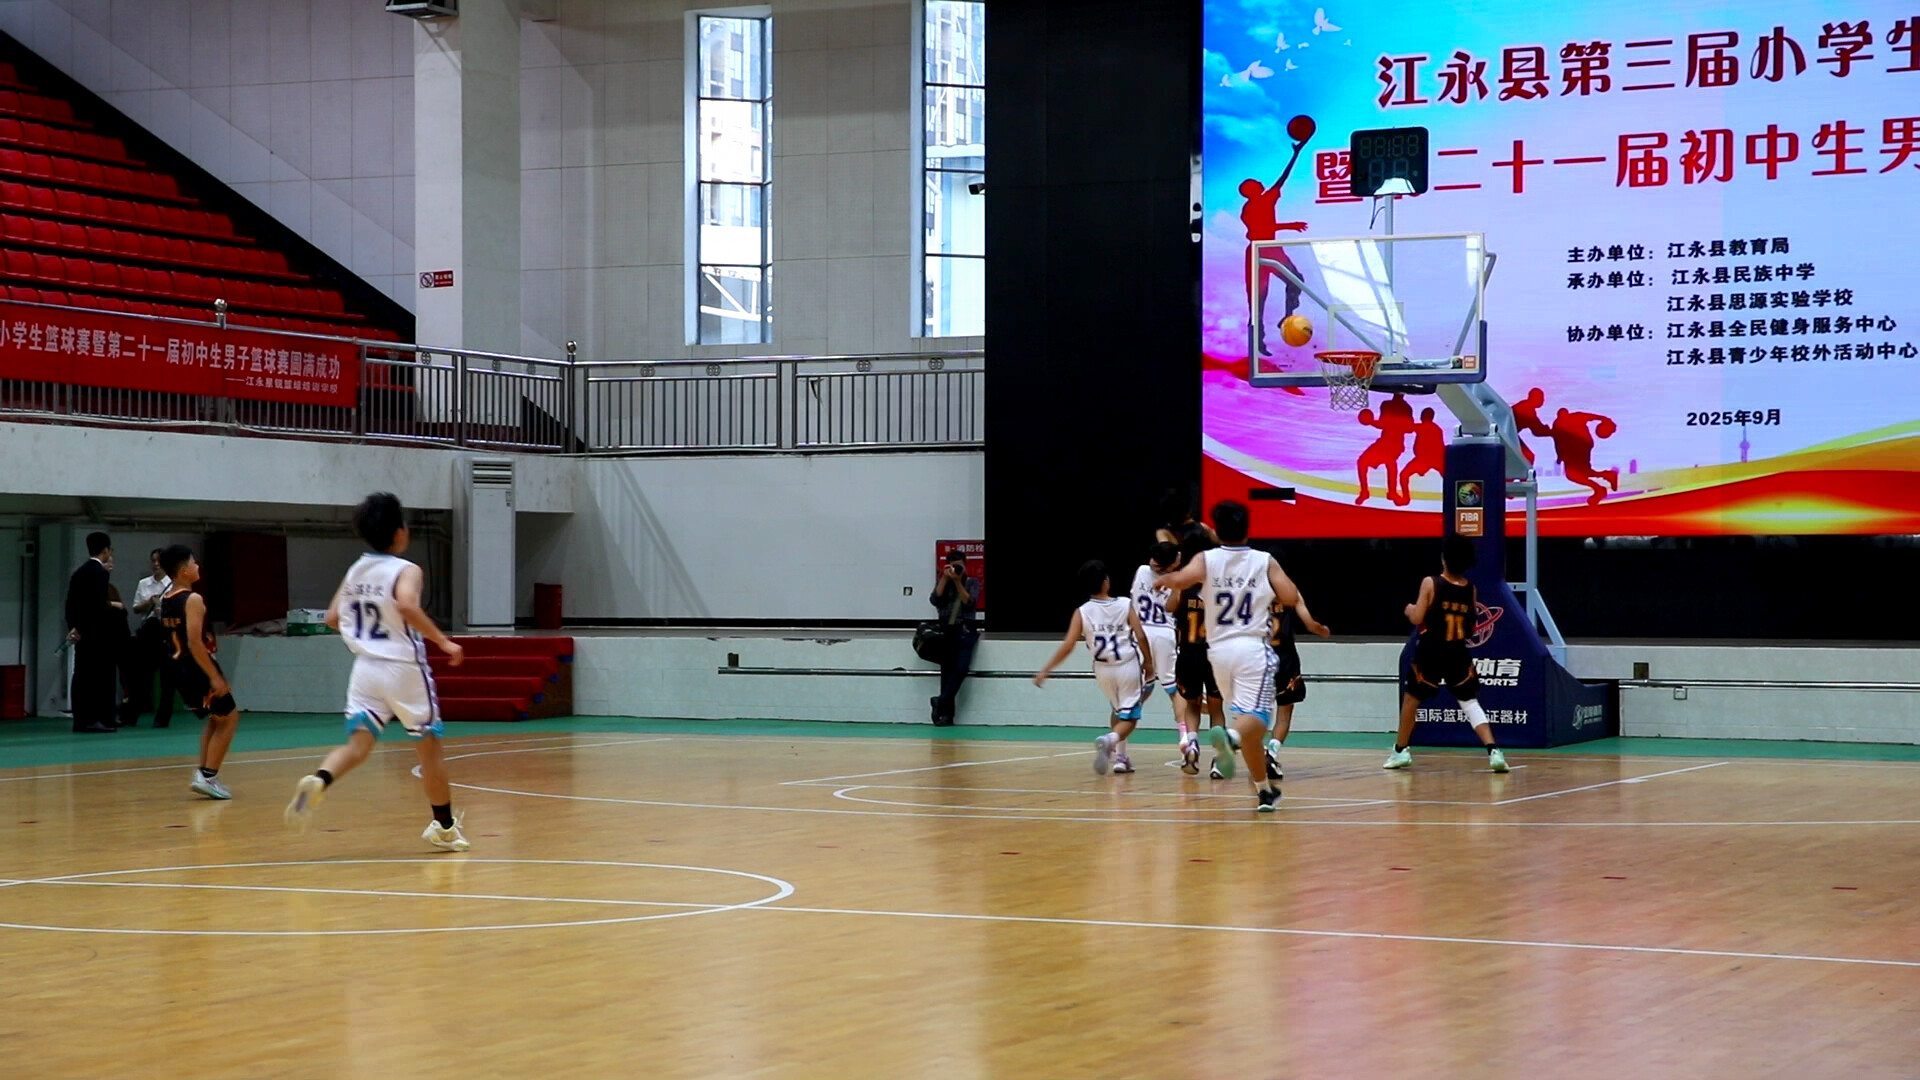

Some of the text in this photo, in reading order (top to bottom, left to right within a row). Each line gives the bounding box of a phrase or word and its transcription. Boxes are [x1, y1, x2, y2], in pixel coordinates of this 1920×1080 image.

[1378, 16, 1920, 108] 江永县第三届小学生
[1315, 117, 1920, 204] 暨二十一届初中生男
[1667, 237, 1790, 258] 江永县教育局
[1671, 263, 1815, 285] 江永县民族中学
[1666, 288, 1853, 312] 江永县思源实验学校
[1666, 315, 1897, 338] 江永县全民健身服务中心
[1666, 342, 1918, 365] 江永县青少年校外活动中心
[1686, 408, 1780, 426] 2025年9月
[1460, 512, 1479, 522] FIBA
[350, 600, 390, 639] 12
[1138, 595, 1167, 624] 30
[1215, 592, 1253, 625] 24
[1094, 635, 1122, 662] 21
[1414, 708, 1529, 725] 国际篮联证器材
